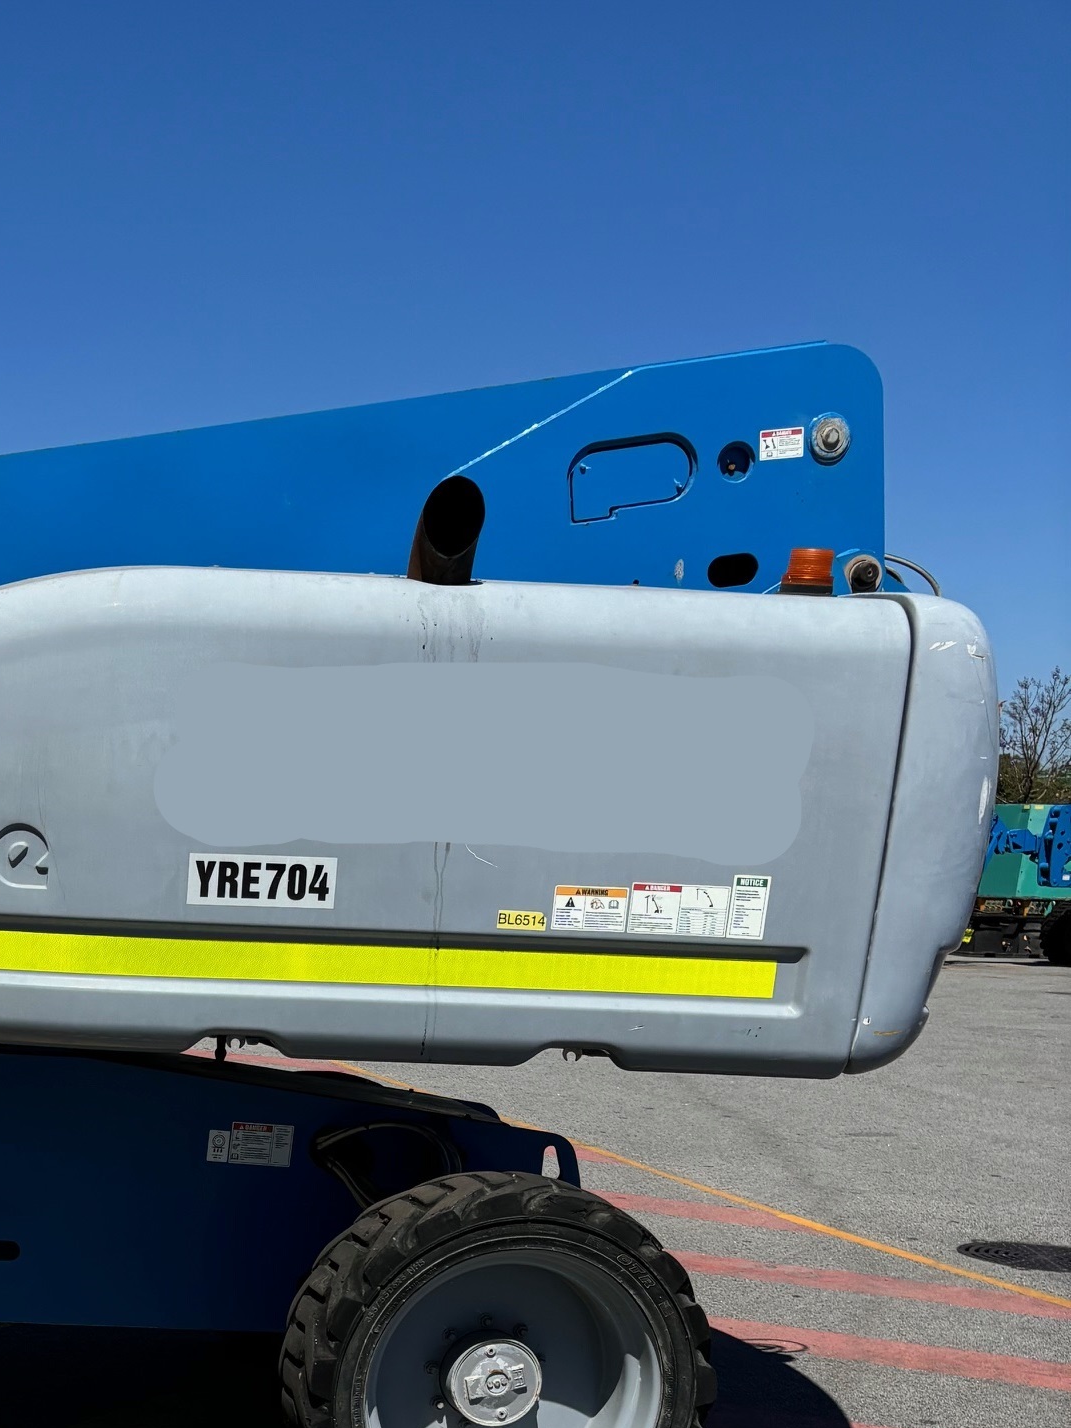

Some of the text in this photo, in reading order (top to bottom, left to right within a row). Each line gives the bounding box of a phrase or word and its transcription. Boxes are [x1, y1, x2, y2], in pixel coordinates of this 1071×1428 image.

[195, 860, 330, 902] YRE704
[740, 878, 764, 887] NOTICE
[582, 888, 609, 897] WARNING
[498, 912, 546, 927] BL6514
[616, 1253, 656, 1289] OTR
